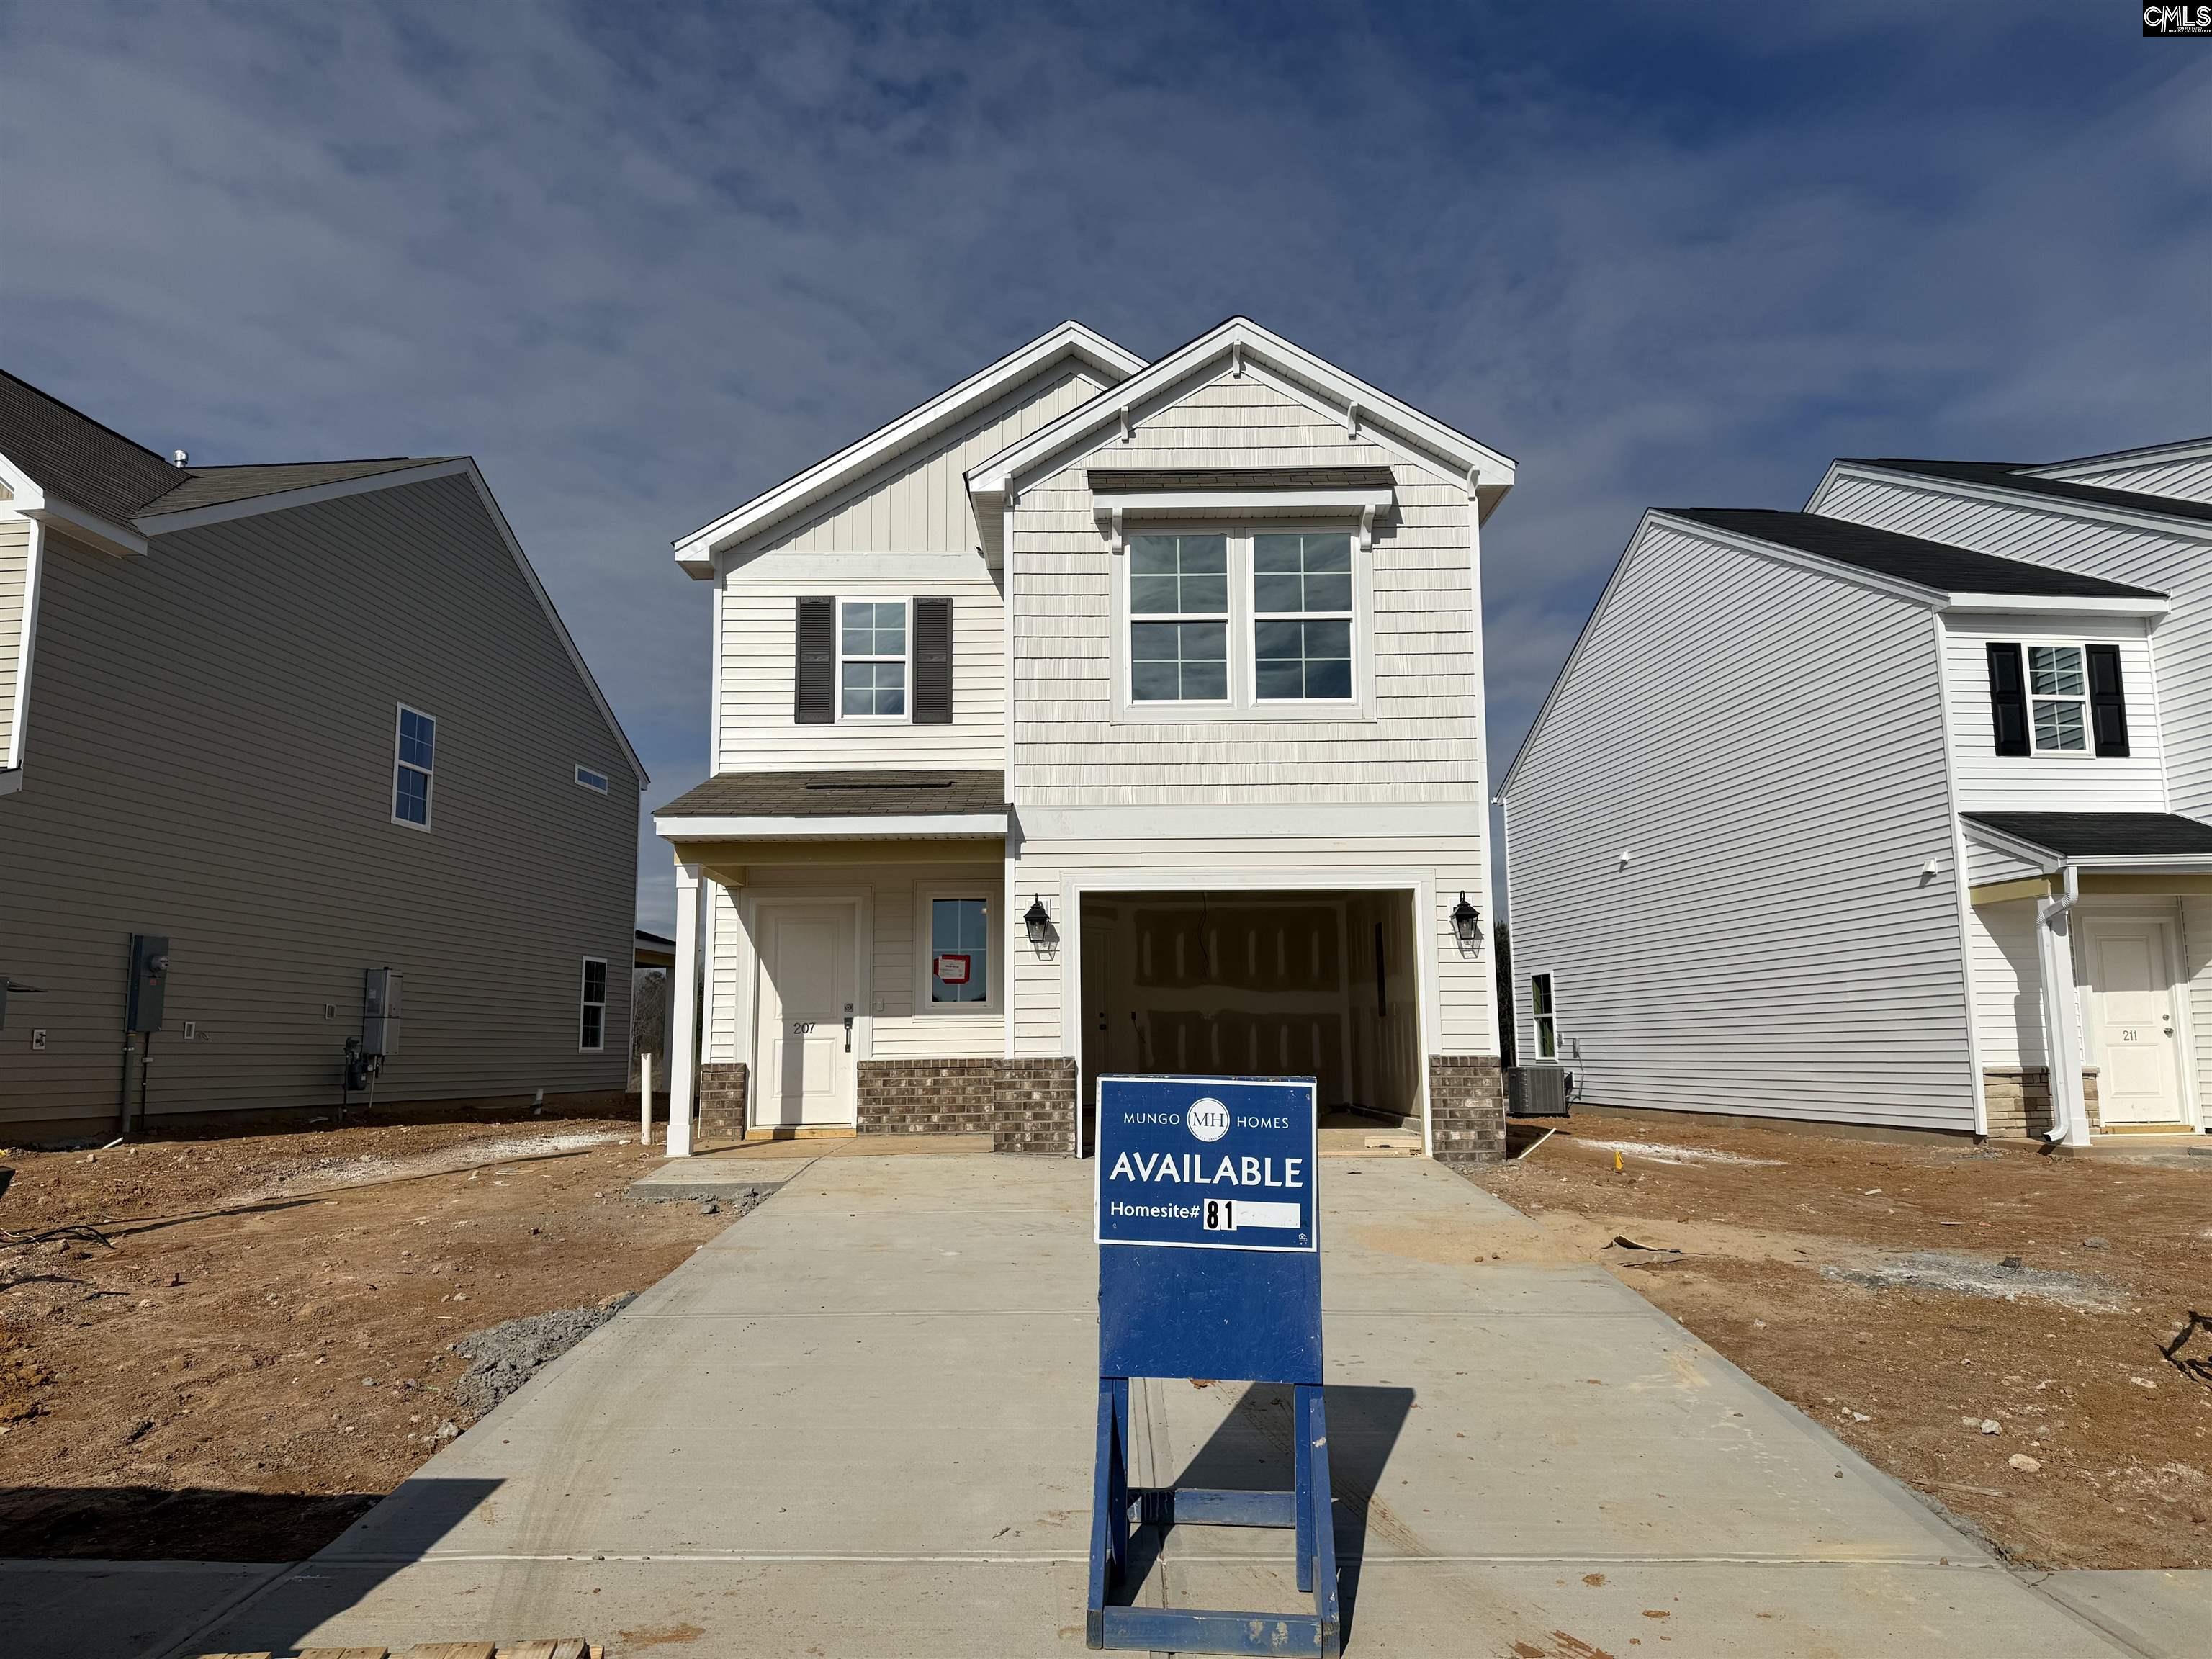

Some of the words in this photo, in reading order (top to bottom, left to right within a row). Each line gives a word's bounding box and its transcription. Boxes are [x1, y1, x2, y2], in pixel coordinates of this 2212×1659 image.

[793, 1022, 817, 1034] 207
[2123, 1030, 2138, 1041] 211
[1123, 1113, 1180, 1125] MUNGO
[1192, 1112, 1225, 1128] MH
[1236, 1116, 1289, 1128] HOMES
[1109, 1151, 1303, 1187] AVAILABLE
[1110, 1201, 1200, 1218] Homesite#
[1206, 1200, 1233, 1229] 81
